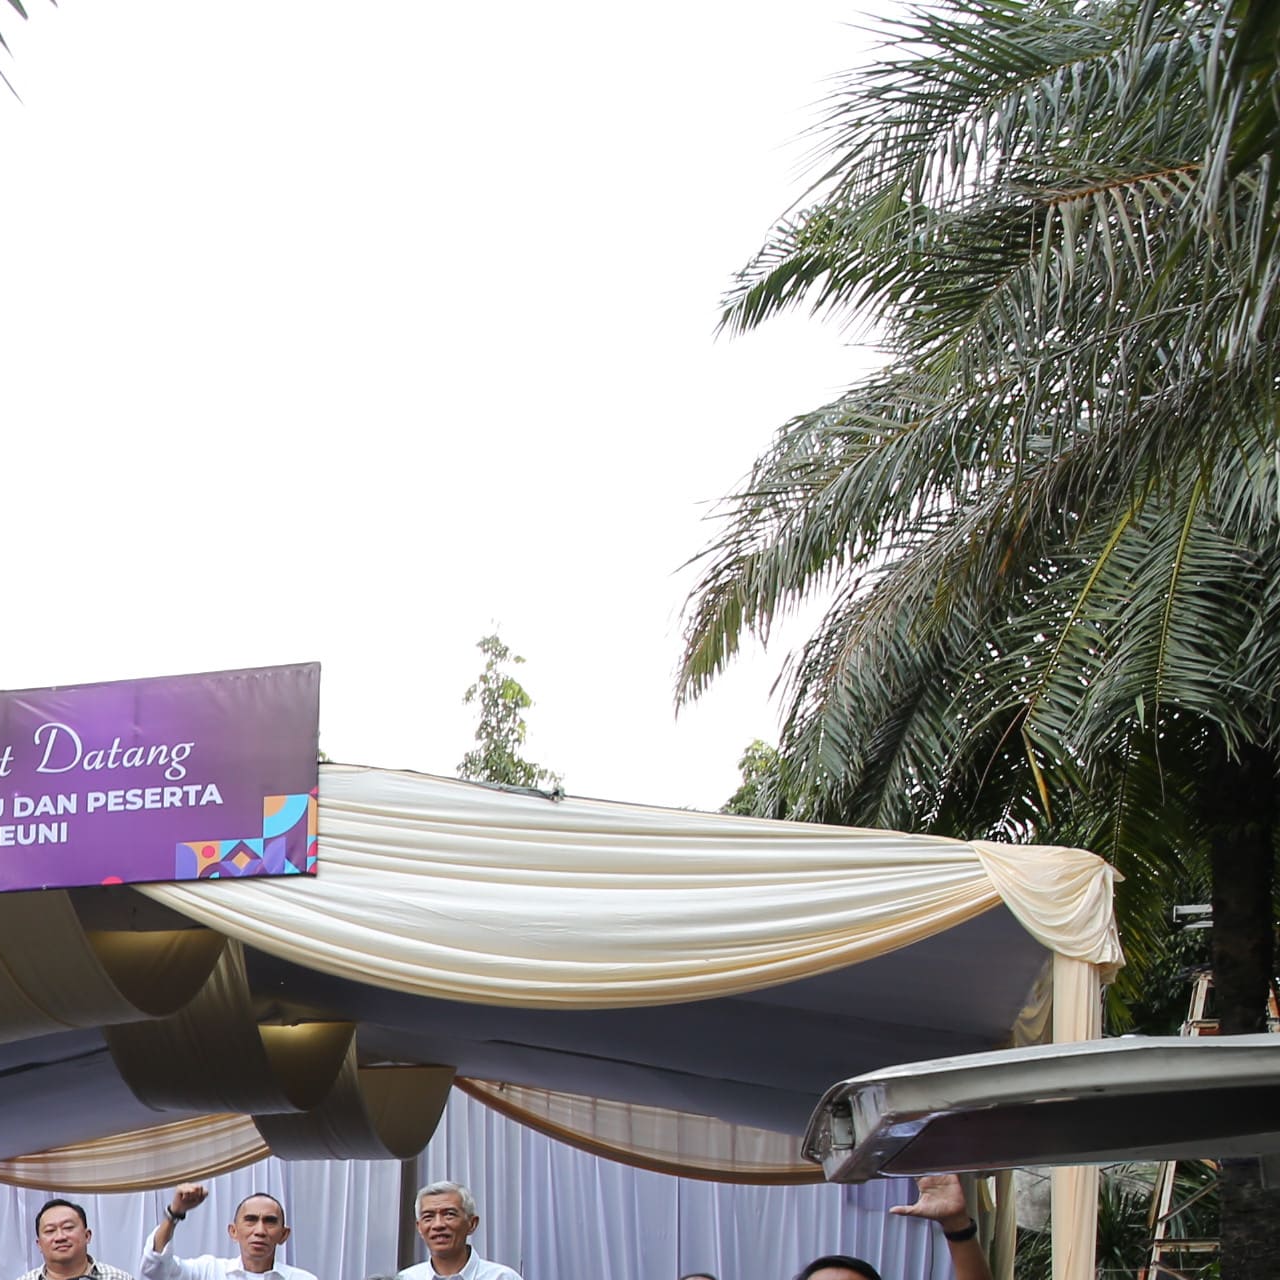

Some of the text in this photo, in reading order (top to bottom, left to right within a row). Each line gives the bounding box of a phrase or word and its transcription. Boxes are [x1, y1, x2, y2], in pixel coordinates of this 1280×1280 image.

[32, 721, 195, 781] Datang
[13, 793, 78, 819] DAN
[87, 783, 223, 813] PESERTA
